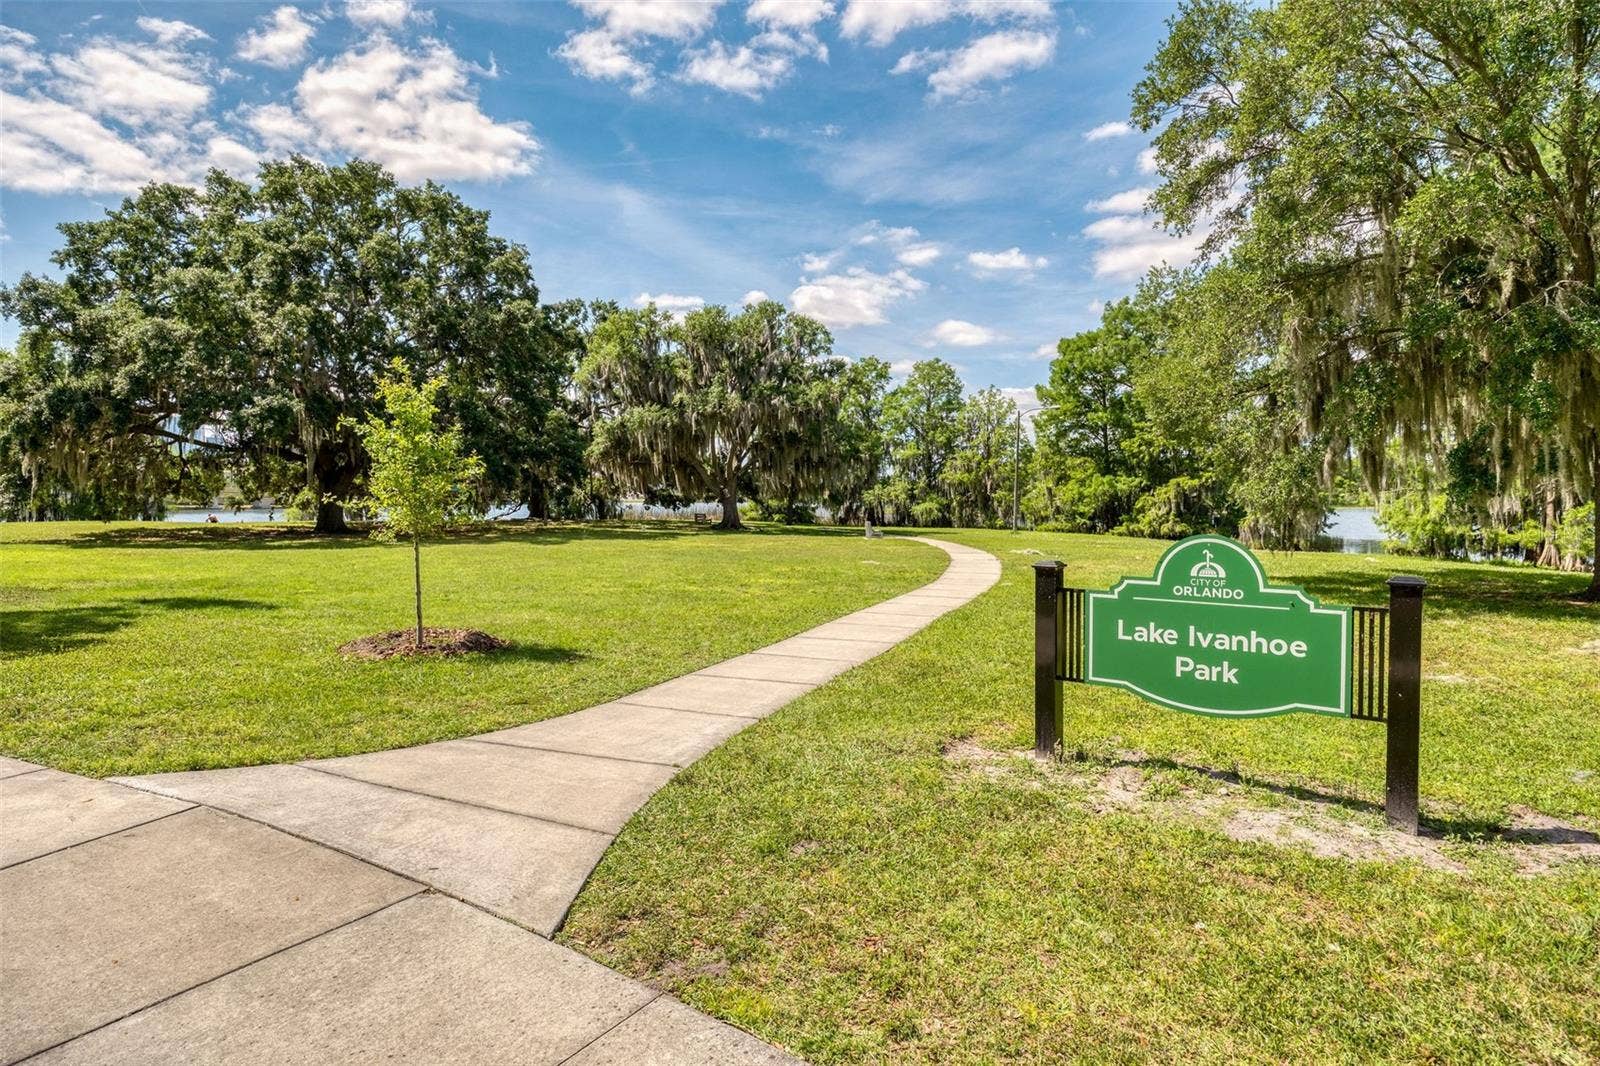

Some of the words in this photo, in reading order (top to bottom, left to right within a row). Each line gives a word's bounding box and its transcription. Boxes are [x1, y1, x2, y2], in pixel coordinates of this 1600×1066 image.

[1173, 585, 1244, 600] ORLANDO
[1190, 578, 1212, 587] CITY
[1213, 579, 1227, 588] OF
[1117, 619, 1178, 645] Lake
[1188, 625, 1308, 658] Ivanhoe
[1175, 656, 1239, 685] Park
